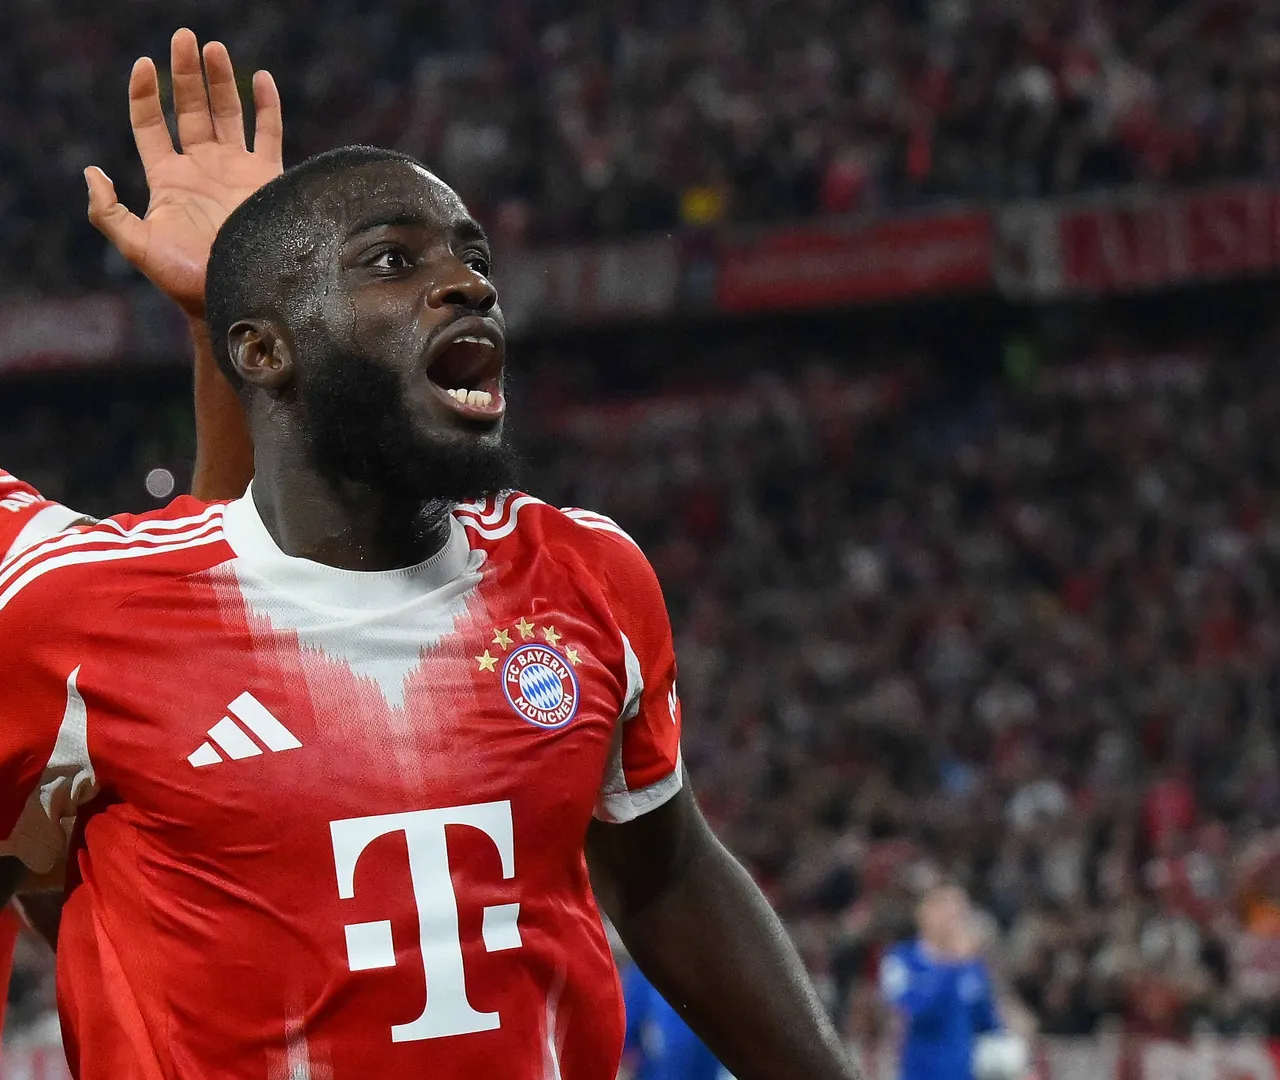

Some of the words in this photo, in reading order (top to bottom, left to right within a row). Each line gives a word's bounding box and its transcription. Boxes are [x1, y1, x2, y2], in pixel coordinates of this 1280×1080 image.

[508, 665, 520, 684] FC
[517, 651, 568, 680] BAYERN
[515, 693, 573, 724] MÜNCHEN
